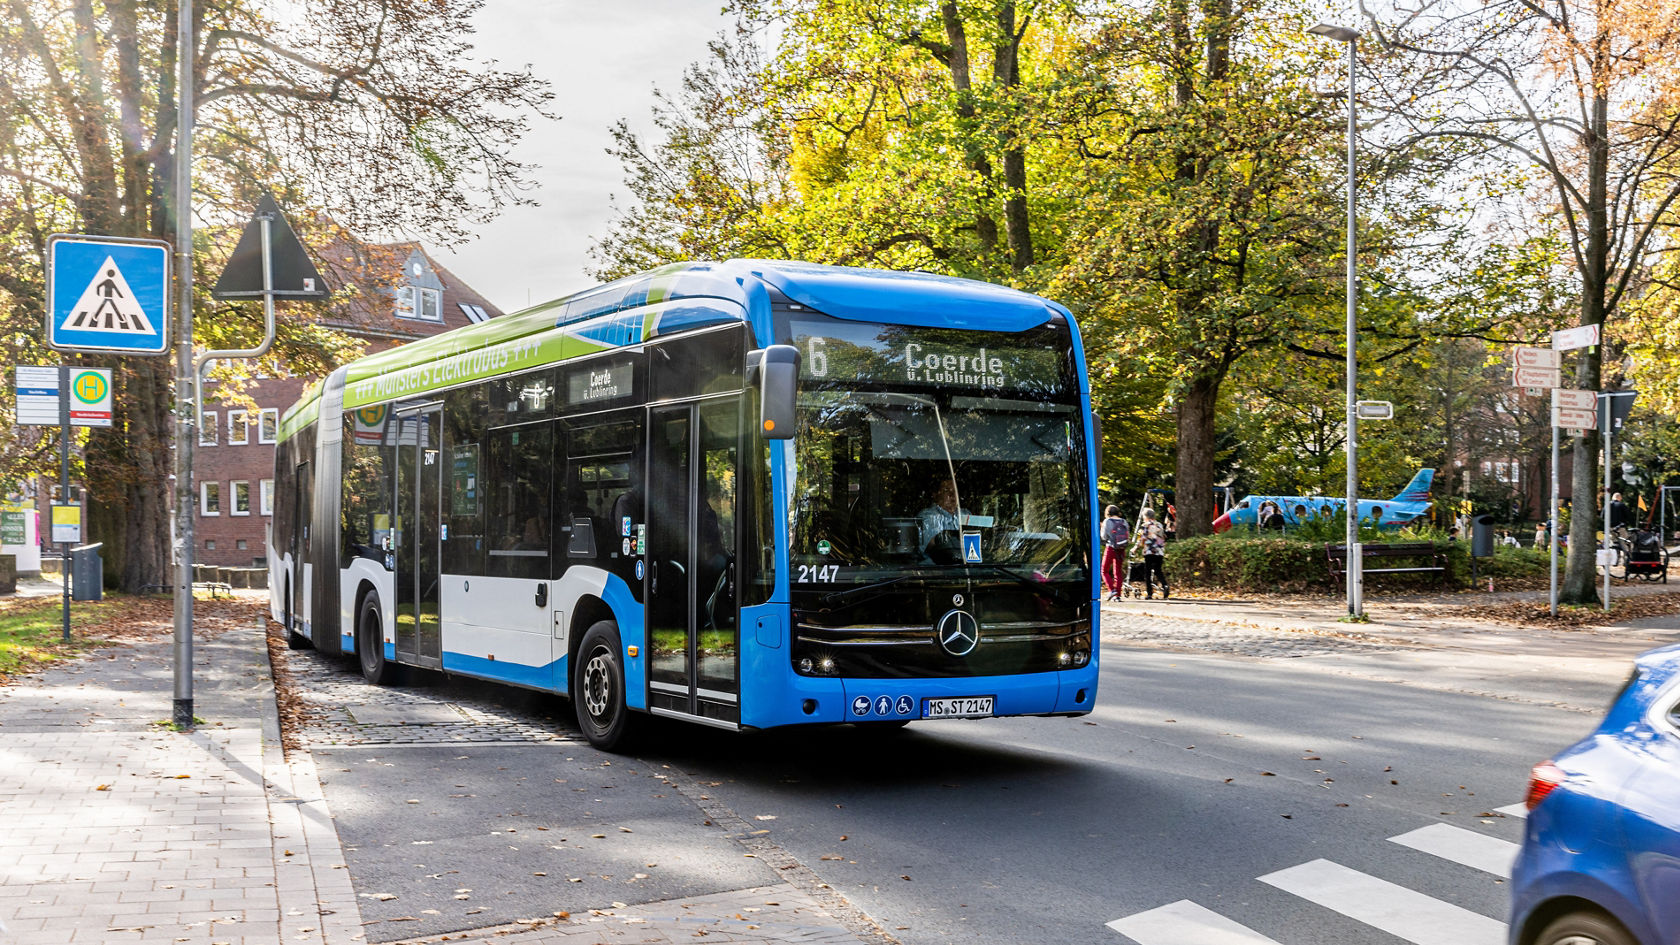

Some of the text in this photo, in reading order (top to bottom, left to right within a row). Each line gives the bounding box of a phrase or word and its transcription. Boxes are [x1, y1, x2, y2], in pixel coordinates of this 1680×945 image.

[433, 338, 508, 384] Elektrobus
[808, 336, 828, 377] 6
[905, 343, 1003, 374] Coerde
[82, 378, 98, 398] H
[590, 369, 611, 387] Coerde
[907, 368, 1005, 388] ü. Lublinring
[797, 564, 840, 583] 2147
[929, 699, 992, 715] MS ST 2147
